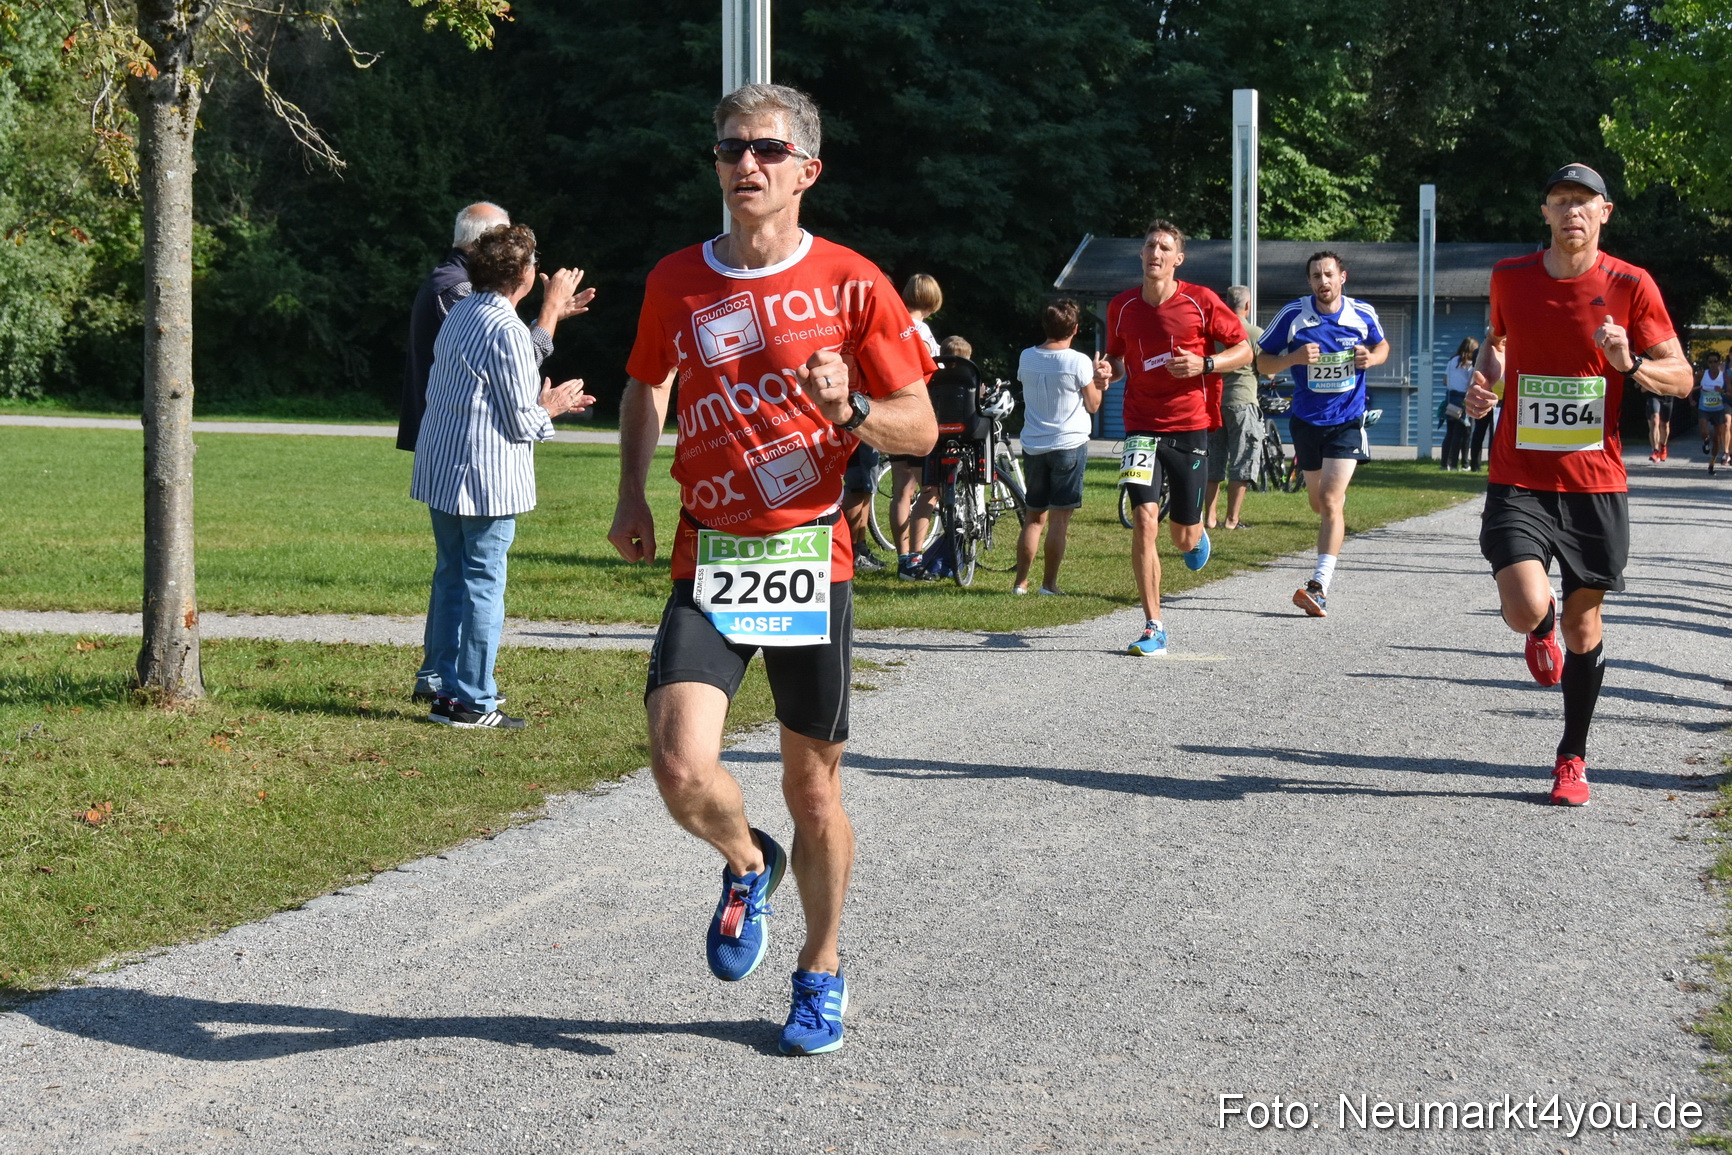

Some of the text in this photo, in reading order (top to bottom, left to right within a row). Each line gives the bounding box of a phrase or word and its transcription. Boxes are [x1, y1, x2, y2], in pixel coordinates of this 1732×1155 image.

[695, 297, 750, 325] raumbox
[774, 323, 843, 346] schenken
[1313, 364, 1350, 379] 2251
[1315, 380, 1350, 389] ANDREAS
[1526, 380, 1596, 396] BOCK
[1528, 402, 1594, 425] 1364
[708, 423, 761, 449] wohnen
[750, 438, 803, 466] raumbox
[702, 508, 753, 528] outdoor
[710, 534, 817, 560] BOCK
[710, 569, 815, 604] 2260
[729, 616, 793, 632] JOSEF
